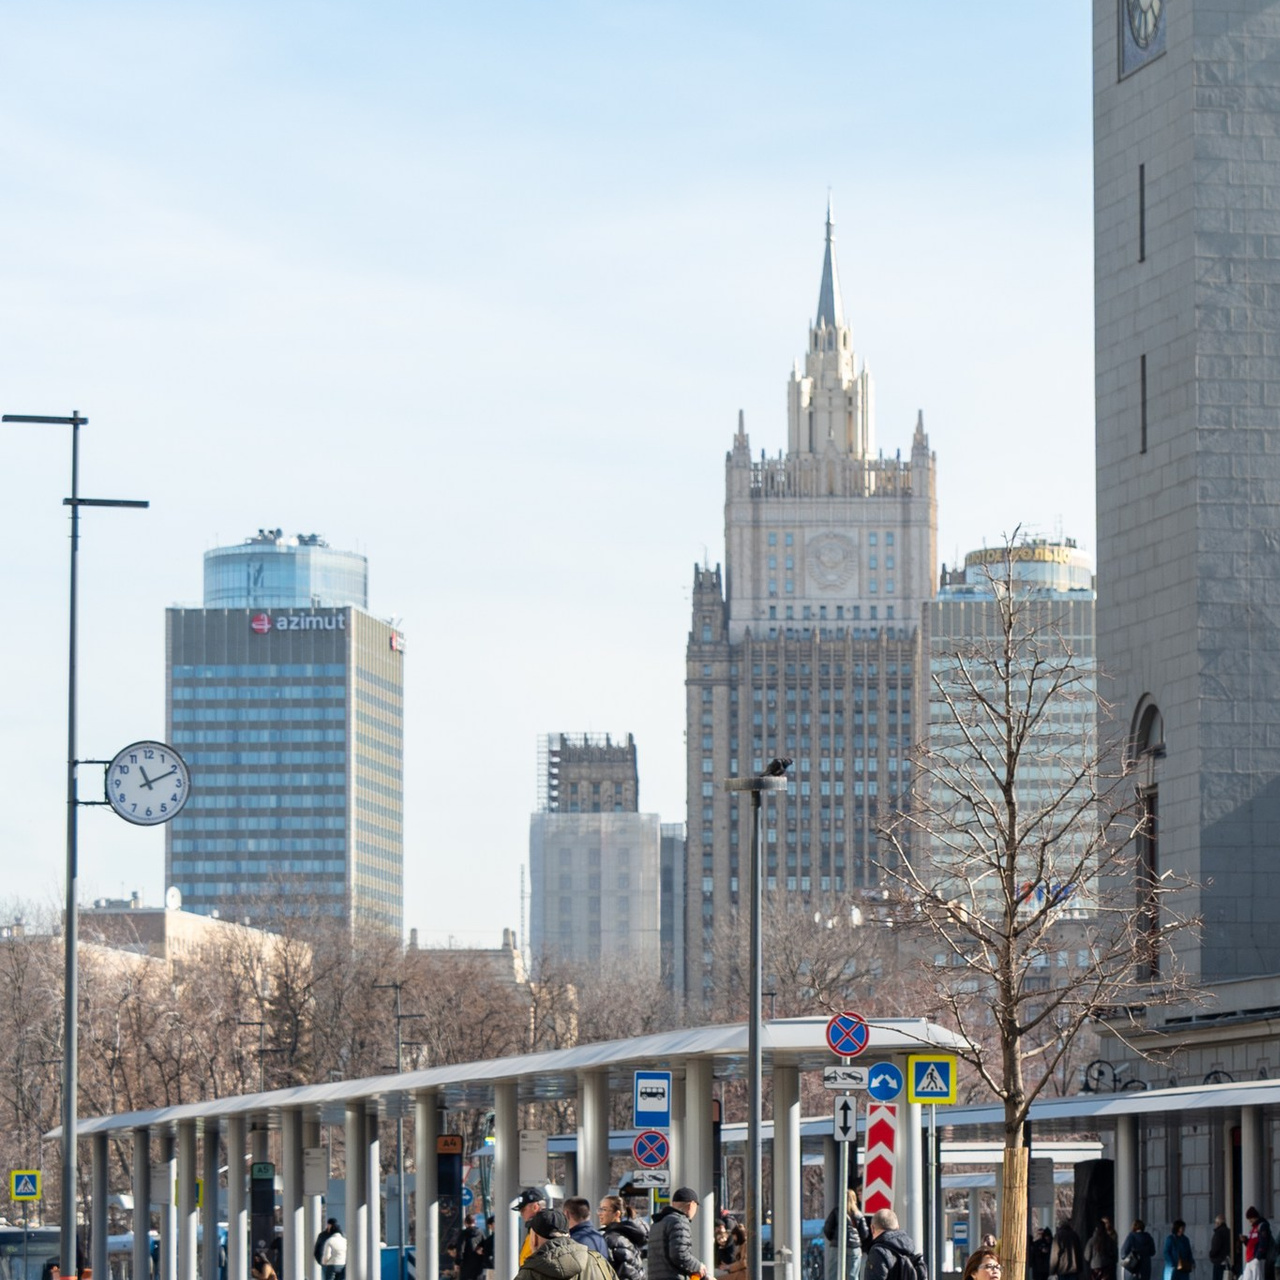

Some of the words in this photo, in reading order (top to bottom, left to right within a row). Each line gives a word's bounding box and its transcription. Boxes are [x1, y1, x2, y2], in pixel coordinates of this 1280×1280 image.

[276, 612, 345, 630] azimut
[129, 754, 137, 764] 11
[143, 750, 154, 759] 12
[160, 754, 165, 764] 1
[119, 765, 129, 774] 10
[171, 764, 178, 774] 2
[114, 779, 121, 788] 9
[175, 779, 182, 788] 3
[119, 793, 126, 803] 8
[170, 793, 178, 802] 4
[131, 803, 137, 813] 7
[145, 807, 152, 817] 6
[160, 803, 167, 812] 5
